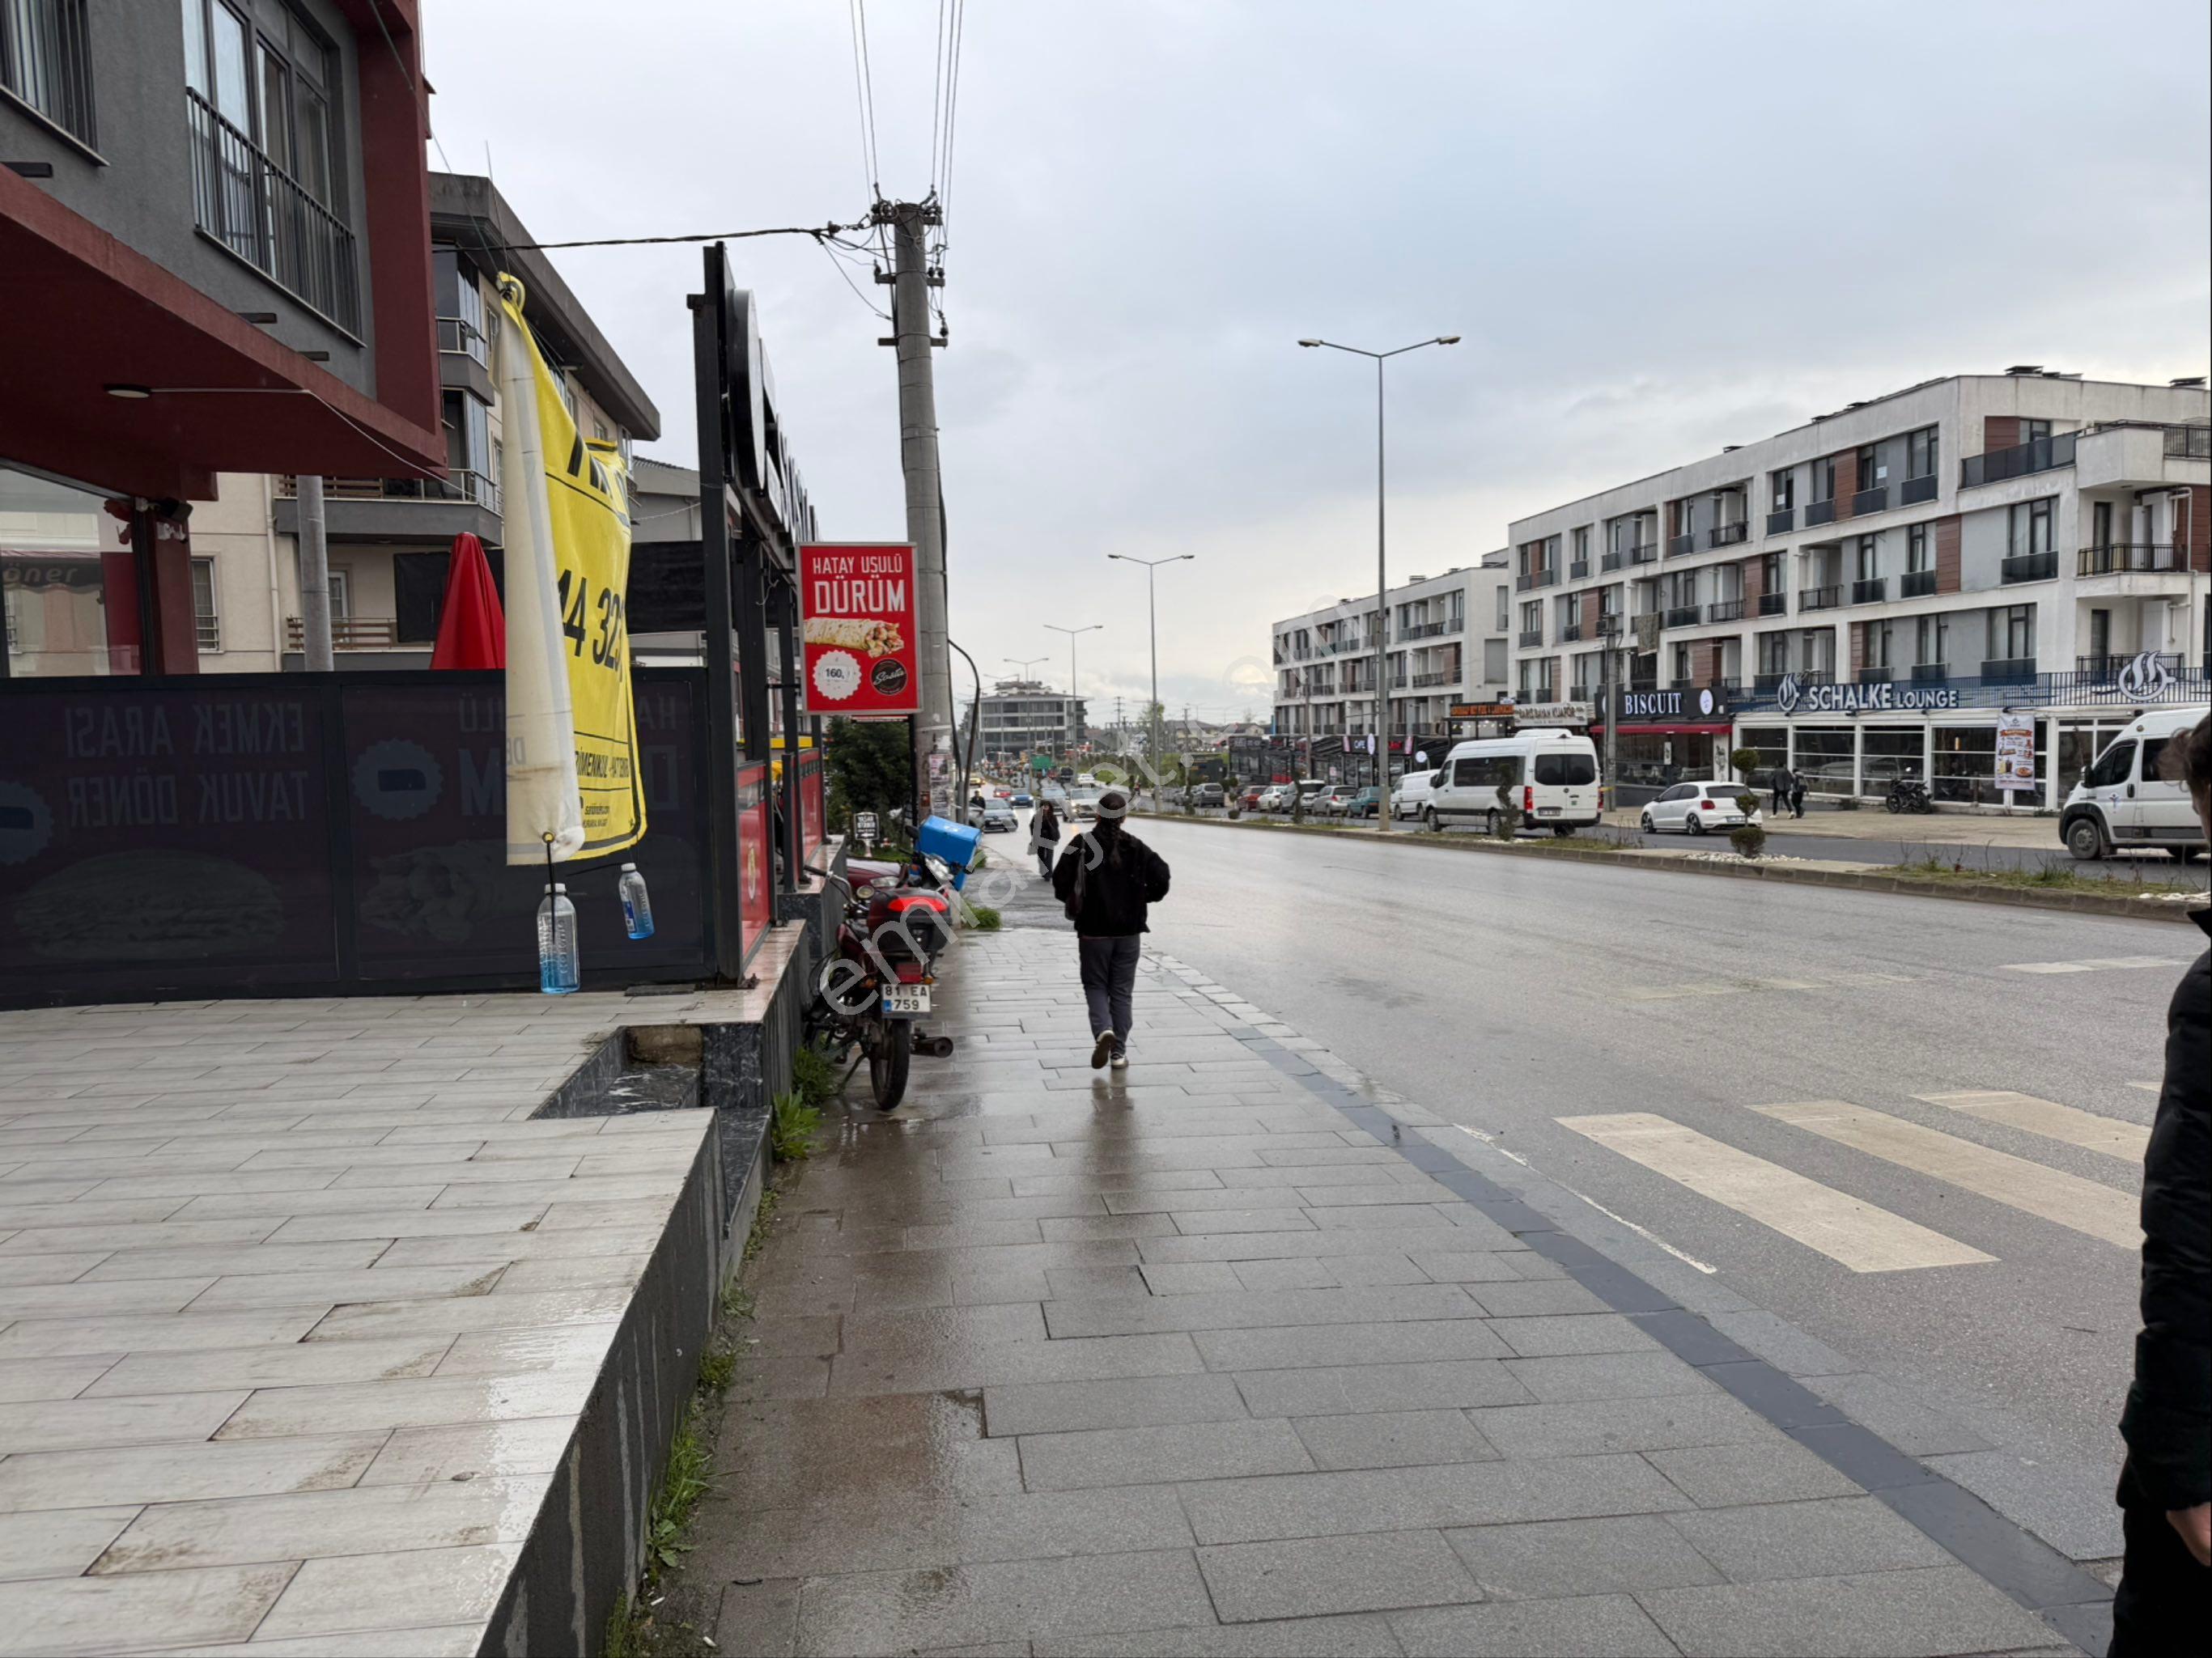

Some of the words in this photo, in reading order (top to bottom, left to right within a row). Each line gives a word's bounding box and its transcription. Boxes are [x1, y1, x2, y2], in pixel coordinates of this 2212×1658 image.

[813, 557, 855, 575] HATAY
[813, 575, 906, 613] DÜRÜM
[1624, 693, 1682, 715] BISCUIT
[1808, 683, 1892, 710] SCHALKE
[1896, 689, 1958, 709] LOUNGE
[885, 986, 901, 996] 81
[911, 986, 928, 997] EA
[894, 999, 919, 1010] 759
